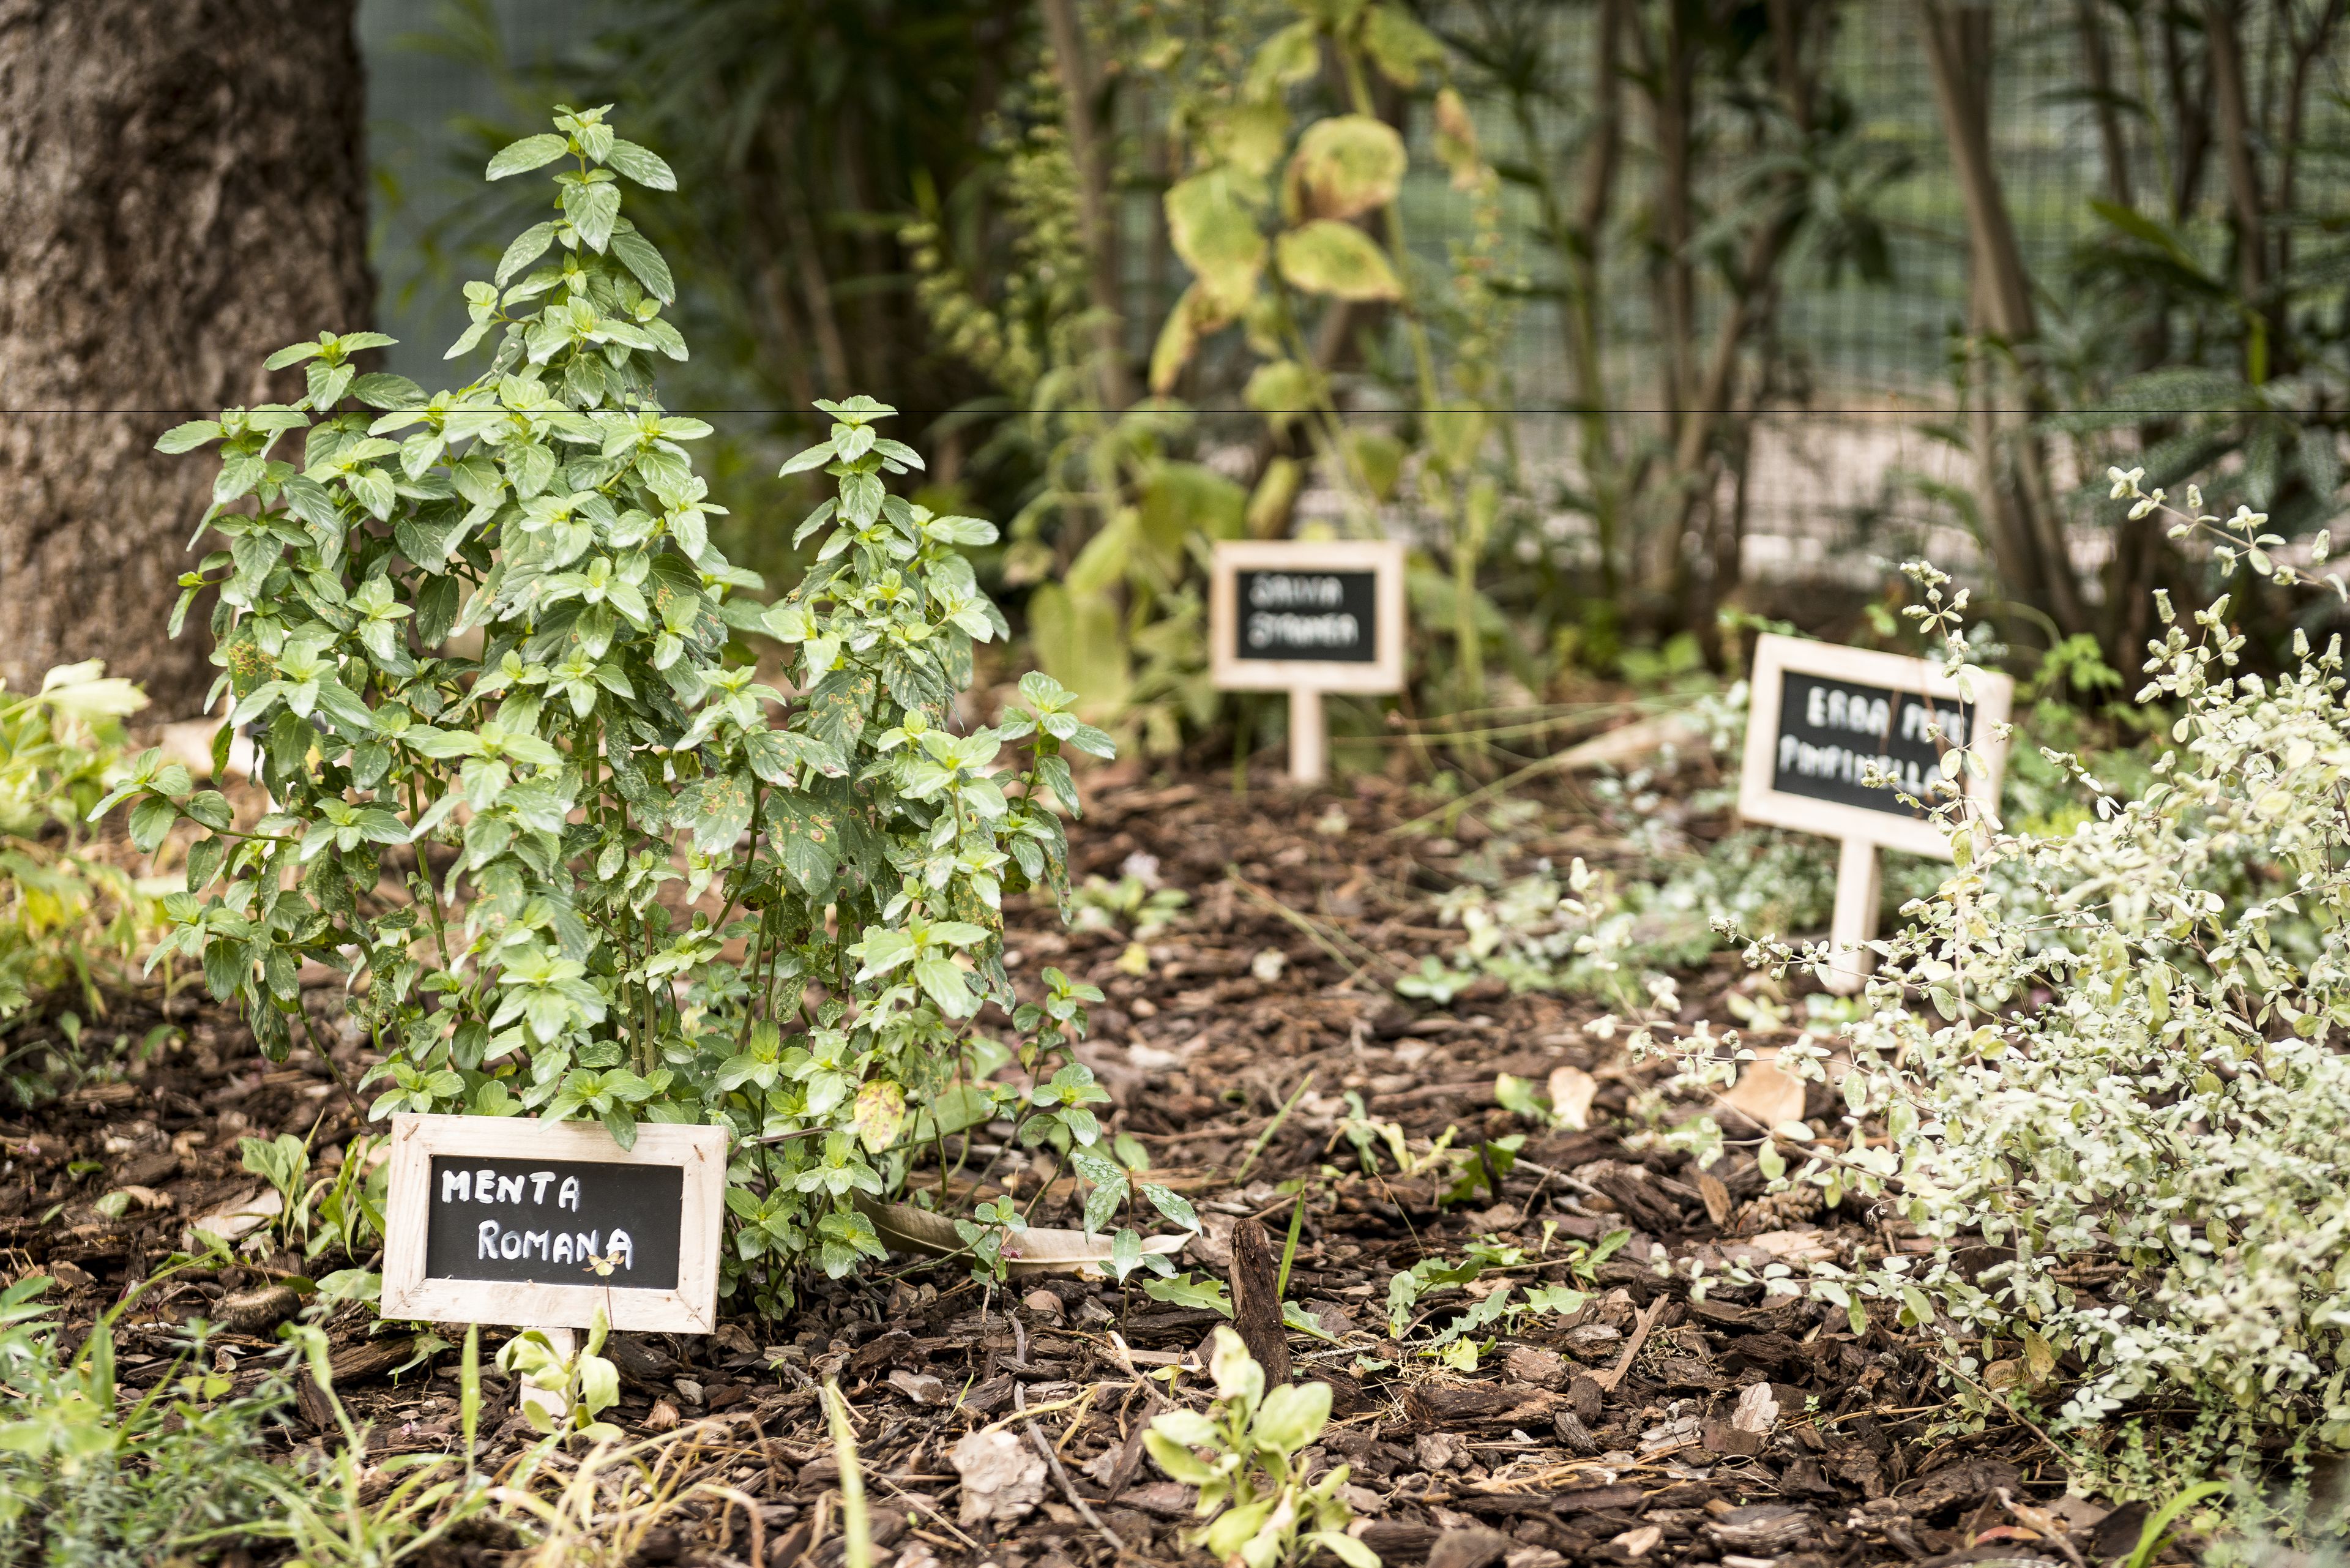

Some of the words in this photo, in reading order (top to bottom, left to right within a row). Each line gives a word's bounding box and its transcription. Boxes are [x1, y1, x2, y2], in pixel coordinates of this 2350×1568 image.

[1807, 685, 1890, 735] ERBA
[441, 1170, 580, 1212] MENTA
[477, 1219, 633, 1271] ROMANA
